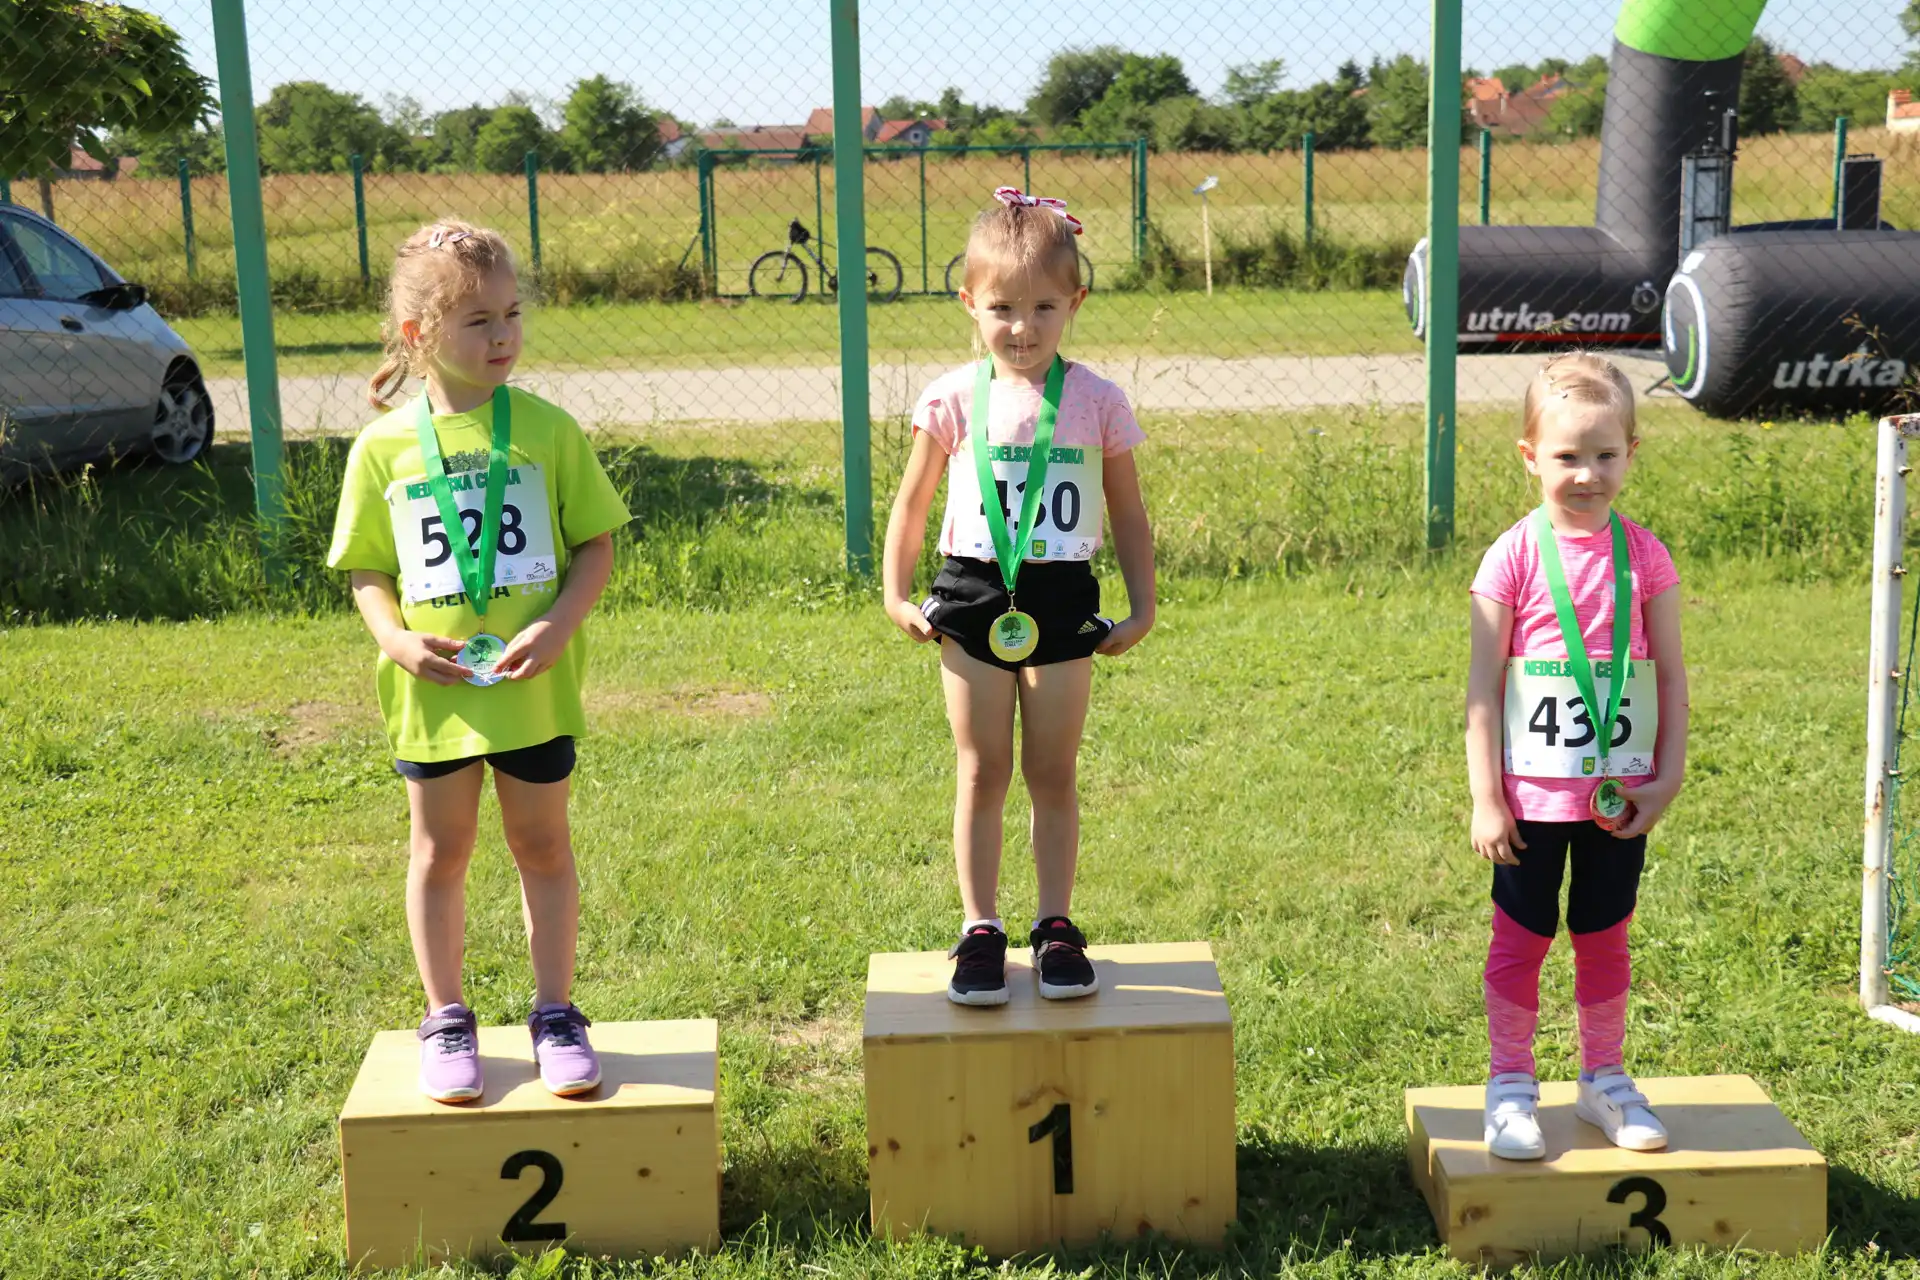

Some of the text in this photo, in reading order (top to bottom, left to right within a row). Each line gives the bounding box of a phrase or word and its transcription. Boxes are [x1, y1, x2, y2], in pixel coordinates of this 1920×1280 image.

[1467, 302, 1632, 332] utrkacom
[421, 503, 527, 567] 528
[980, 480, 1080, 532] 430
[1528, 696, 1632, 748] 435
[1028, 1104, 1074, 1195] 1
[500, 1149, 567, 1242] 2
[1605, 1176, 1672, 1255] 3
